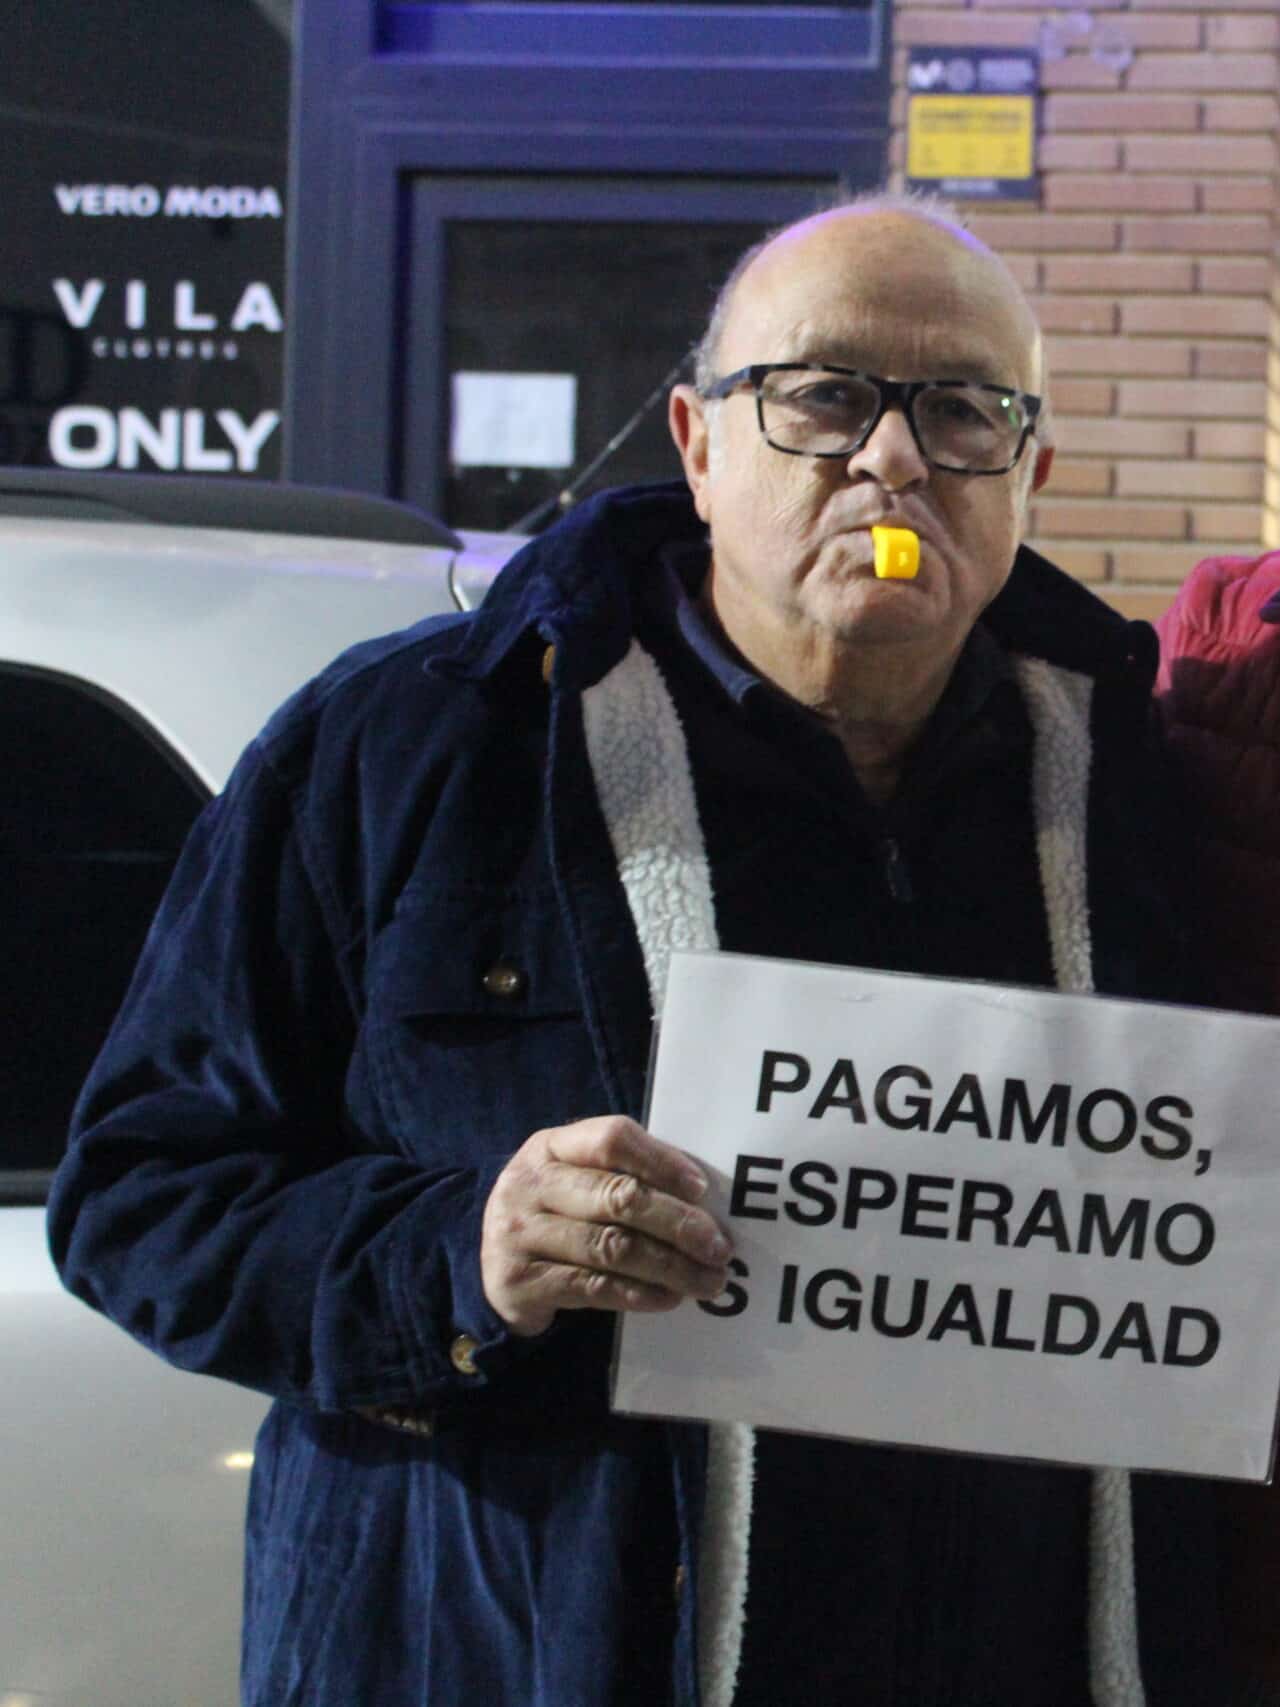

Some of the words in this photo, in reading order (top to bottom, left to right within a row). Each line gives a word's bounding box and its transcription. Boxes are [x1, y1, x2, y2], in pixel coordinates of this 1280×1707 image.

[55, 185, 160, 217] VERO
[164, 187, 282, 218] MODA
[53, 279, 283, 332] VILA
[49, 406, 280, 471] ONLY
[756, 1050, 1213, 1177] PAGAMOS,
[728, 1154, 1216, 1267] ESPERAMO
[776, 1263, 1222, 1368] IGUALDAD
